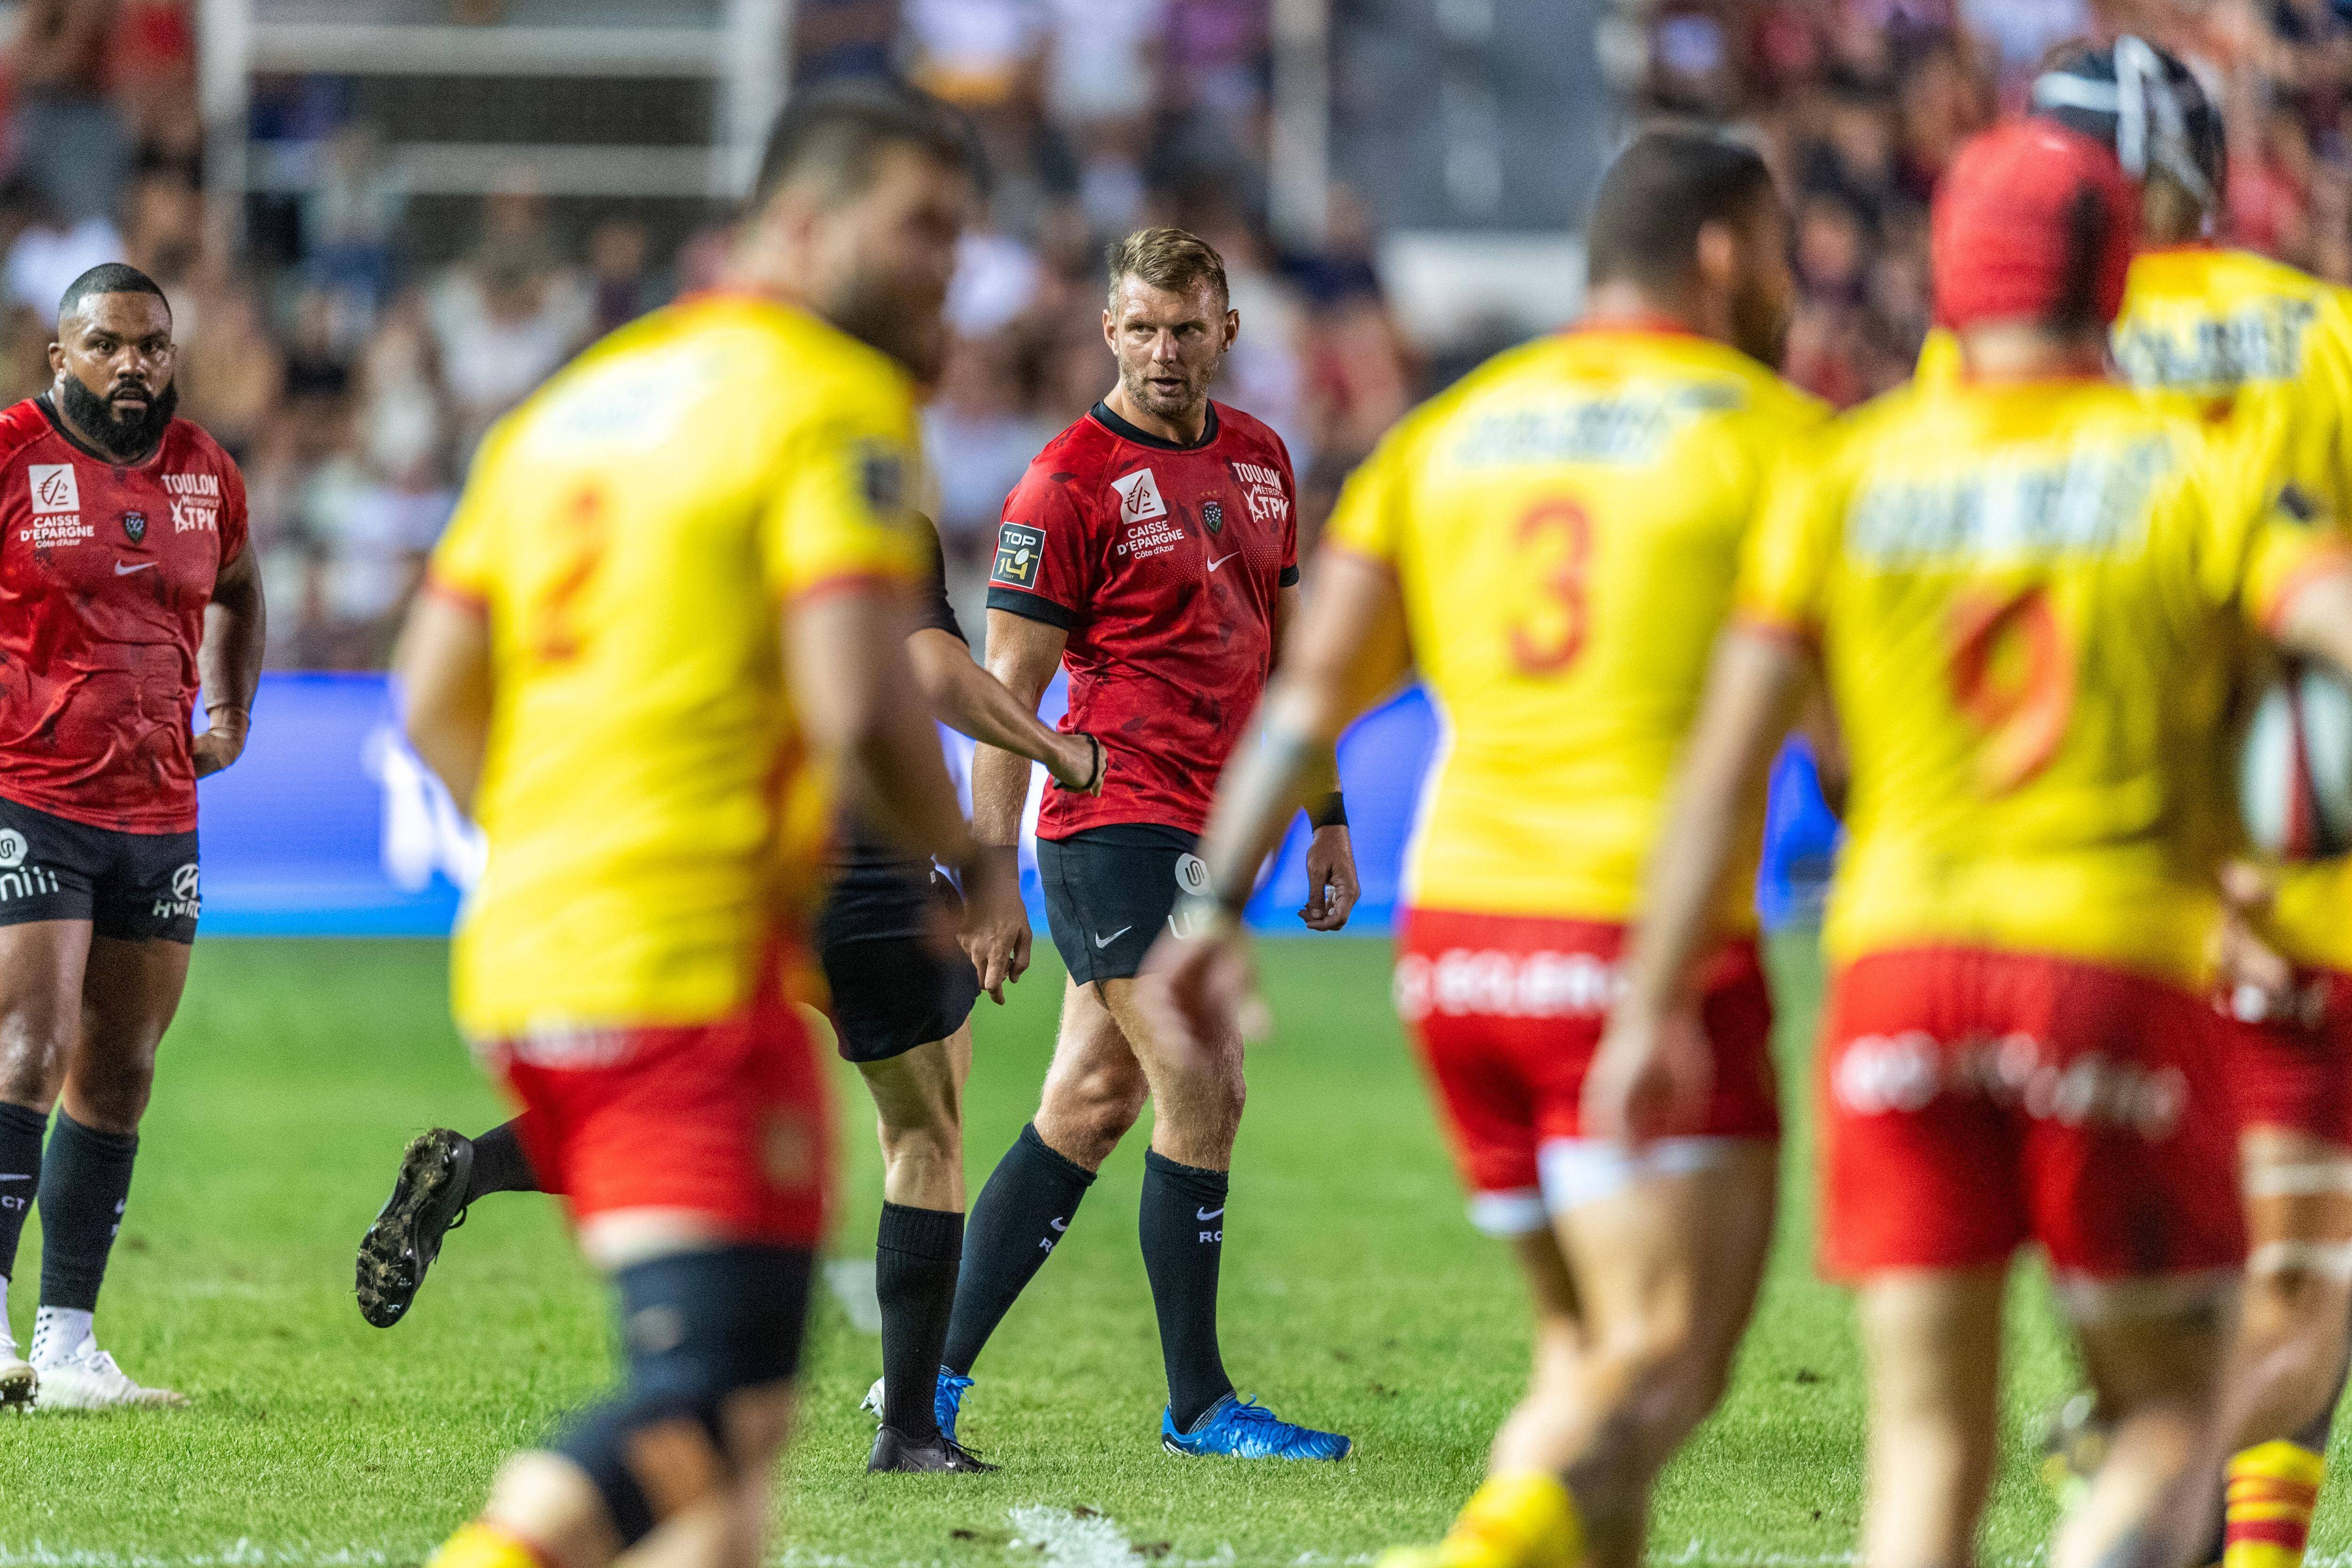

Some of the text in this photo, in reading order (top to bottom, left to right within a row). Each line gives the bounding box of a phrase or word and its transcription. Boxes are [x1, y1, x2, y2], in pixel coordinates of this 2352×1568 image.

[160, 473, 219, 497] TOULON
[1232, 462, 1282, 491] TOULON
[1253, 484, 1289, 501] MÉTROP
[33, 515, 81, 529] CAISSE
[184, 508, 217, 532] TPK
[1128, 520, 1169, 539] CAISSE
[20, 525, 95, 542] D'EPARGNE
[1004, 531, 1036, 547] TOP
[1117, 529, 1184, 556] D'EPARGNE
[1134, 544, 1175, 559] Côte d'Azur
[998, 557, 1028, 580] 14
[1510, 496, 1595, 675] 3
